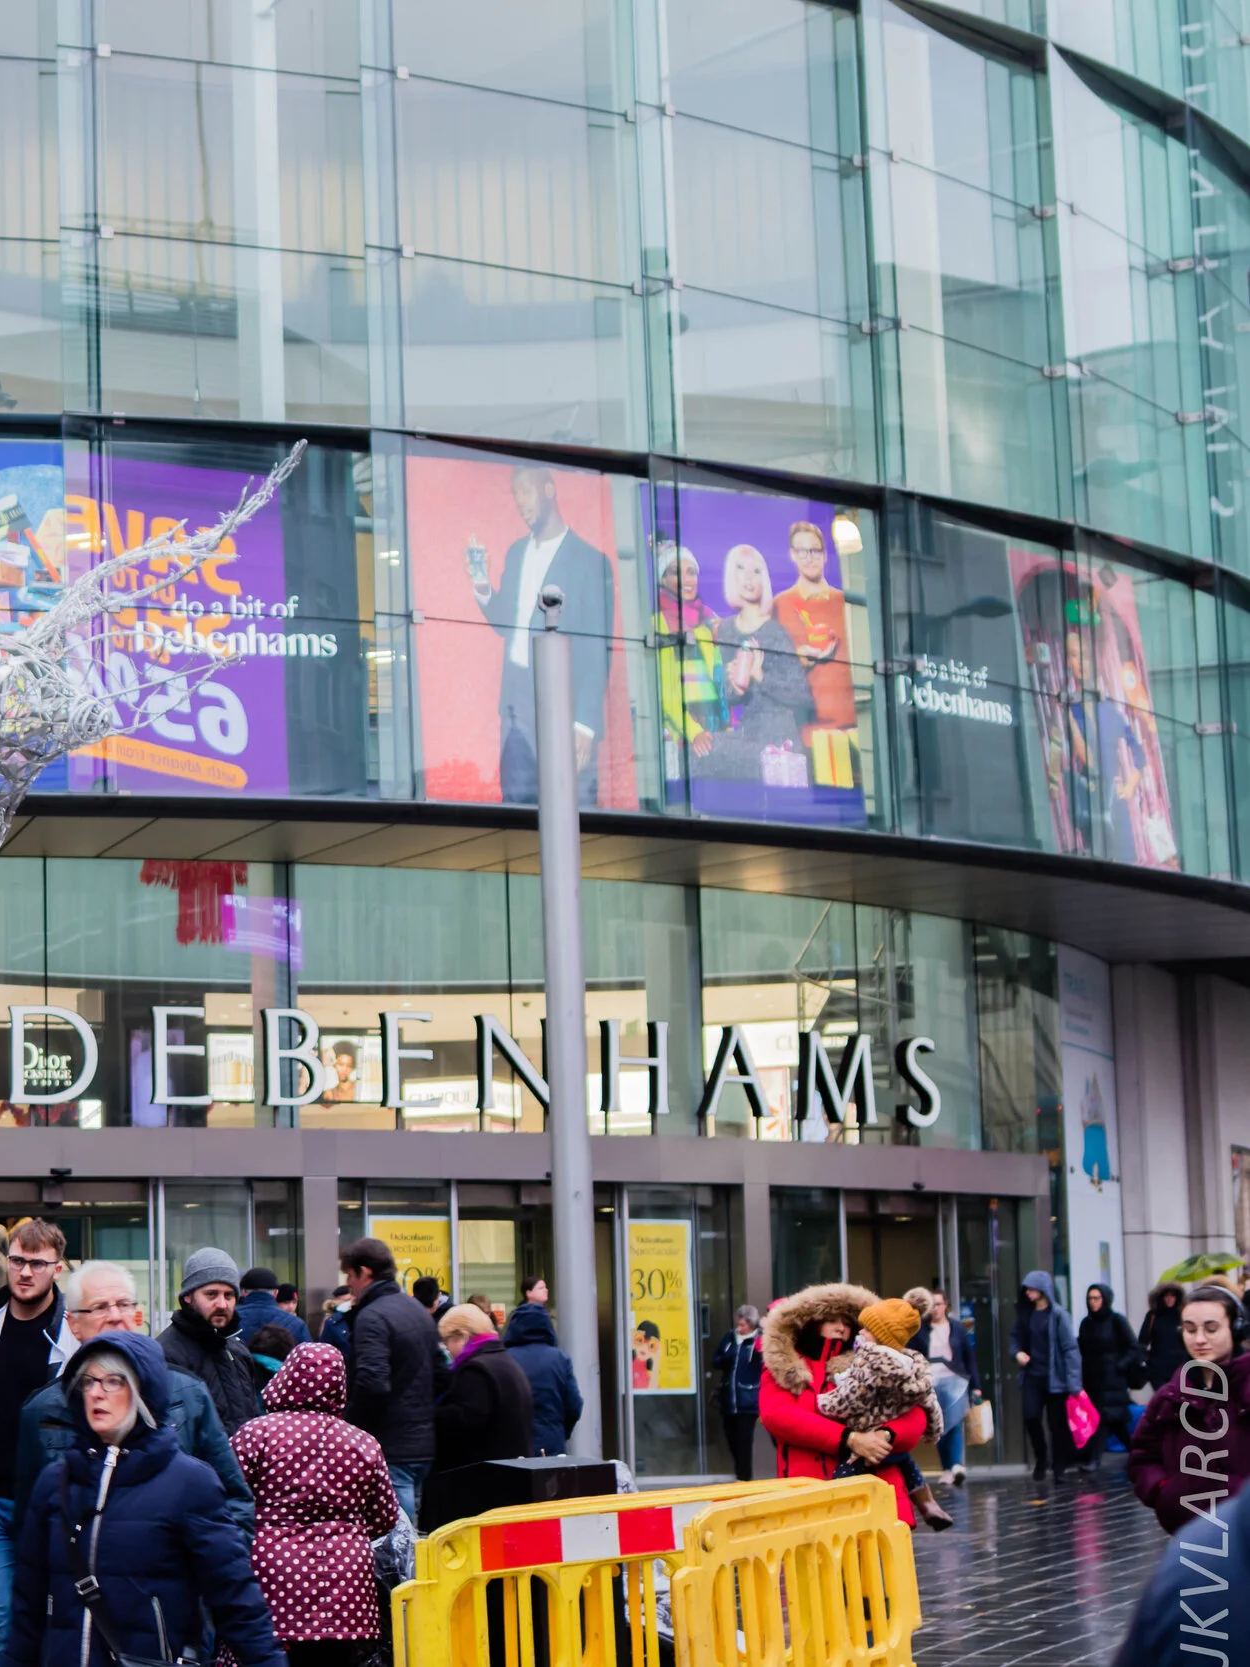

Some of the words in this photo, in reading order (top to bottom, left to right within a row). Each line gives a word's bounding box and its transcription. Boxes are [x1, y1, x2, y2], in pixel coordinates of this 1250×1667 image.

[171, 593, 204, 618] do
[210, 601, 224, 618] a
[230, 594, 265, 619] bit
[270, 595, 299, 619] of
[134, 621, 338, 657] Debenhams
[949, 659, 971, 685] bit
[972, 666, 988, 689] of
[896, 674, 1013, 726] Debenhams
[8, 1005, 943, 1129] DEBENHAMS
[24, 1042, 72, 1069] Dior
[630, 1268, 683, 1302] 30%
